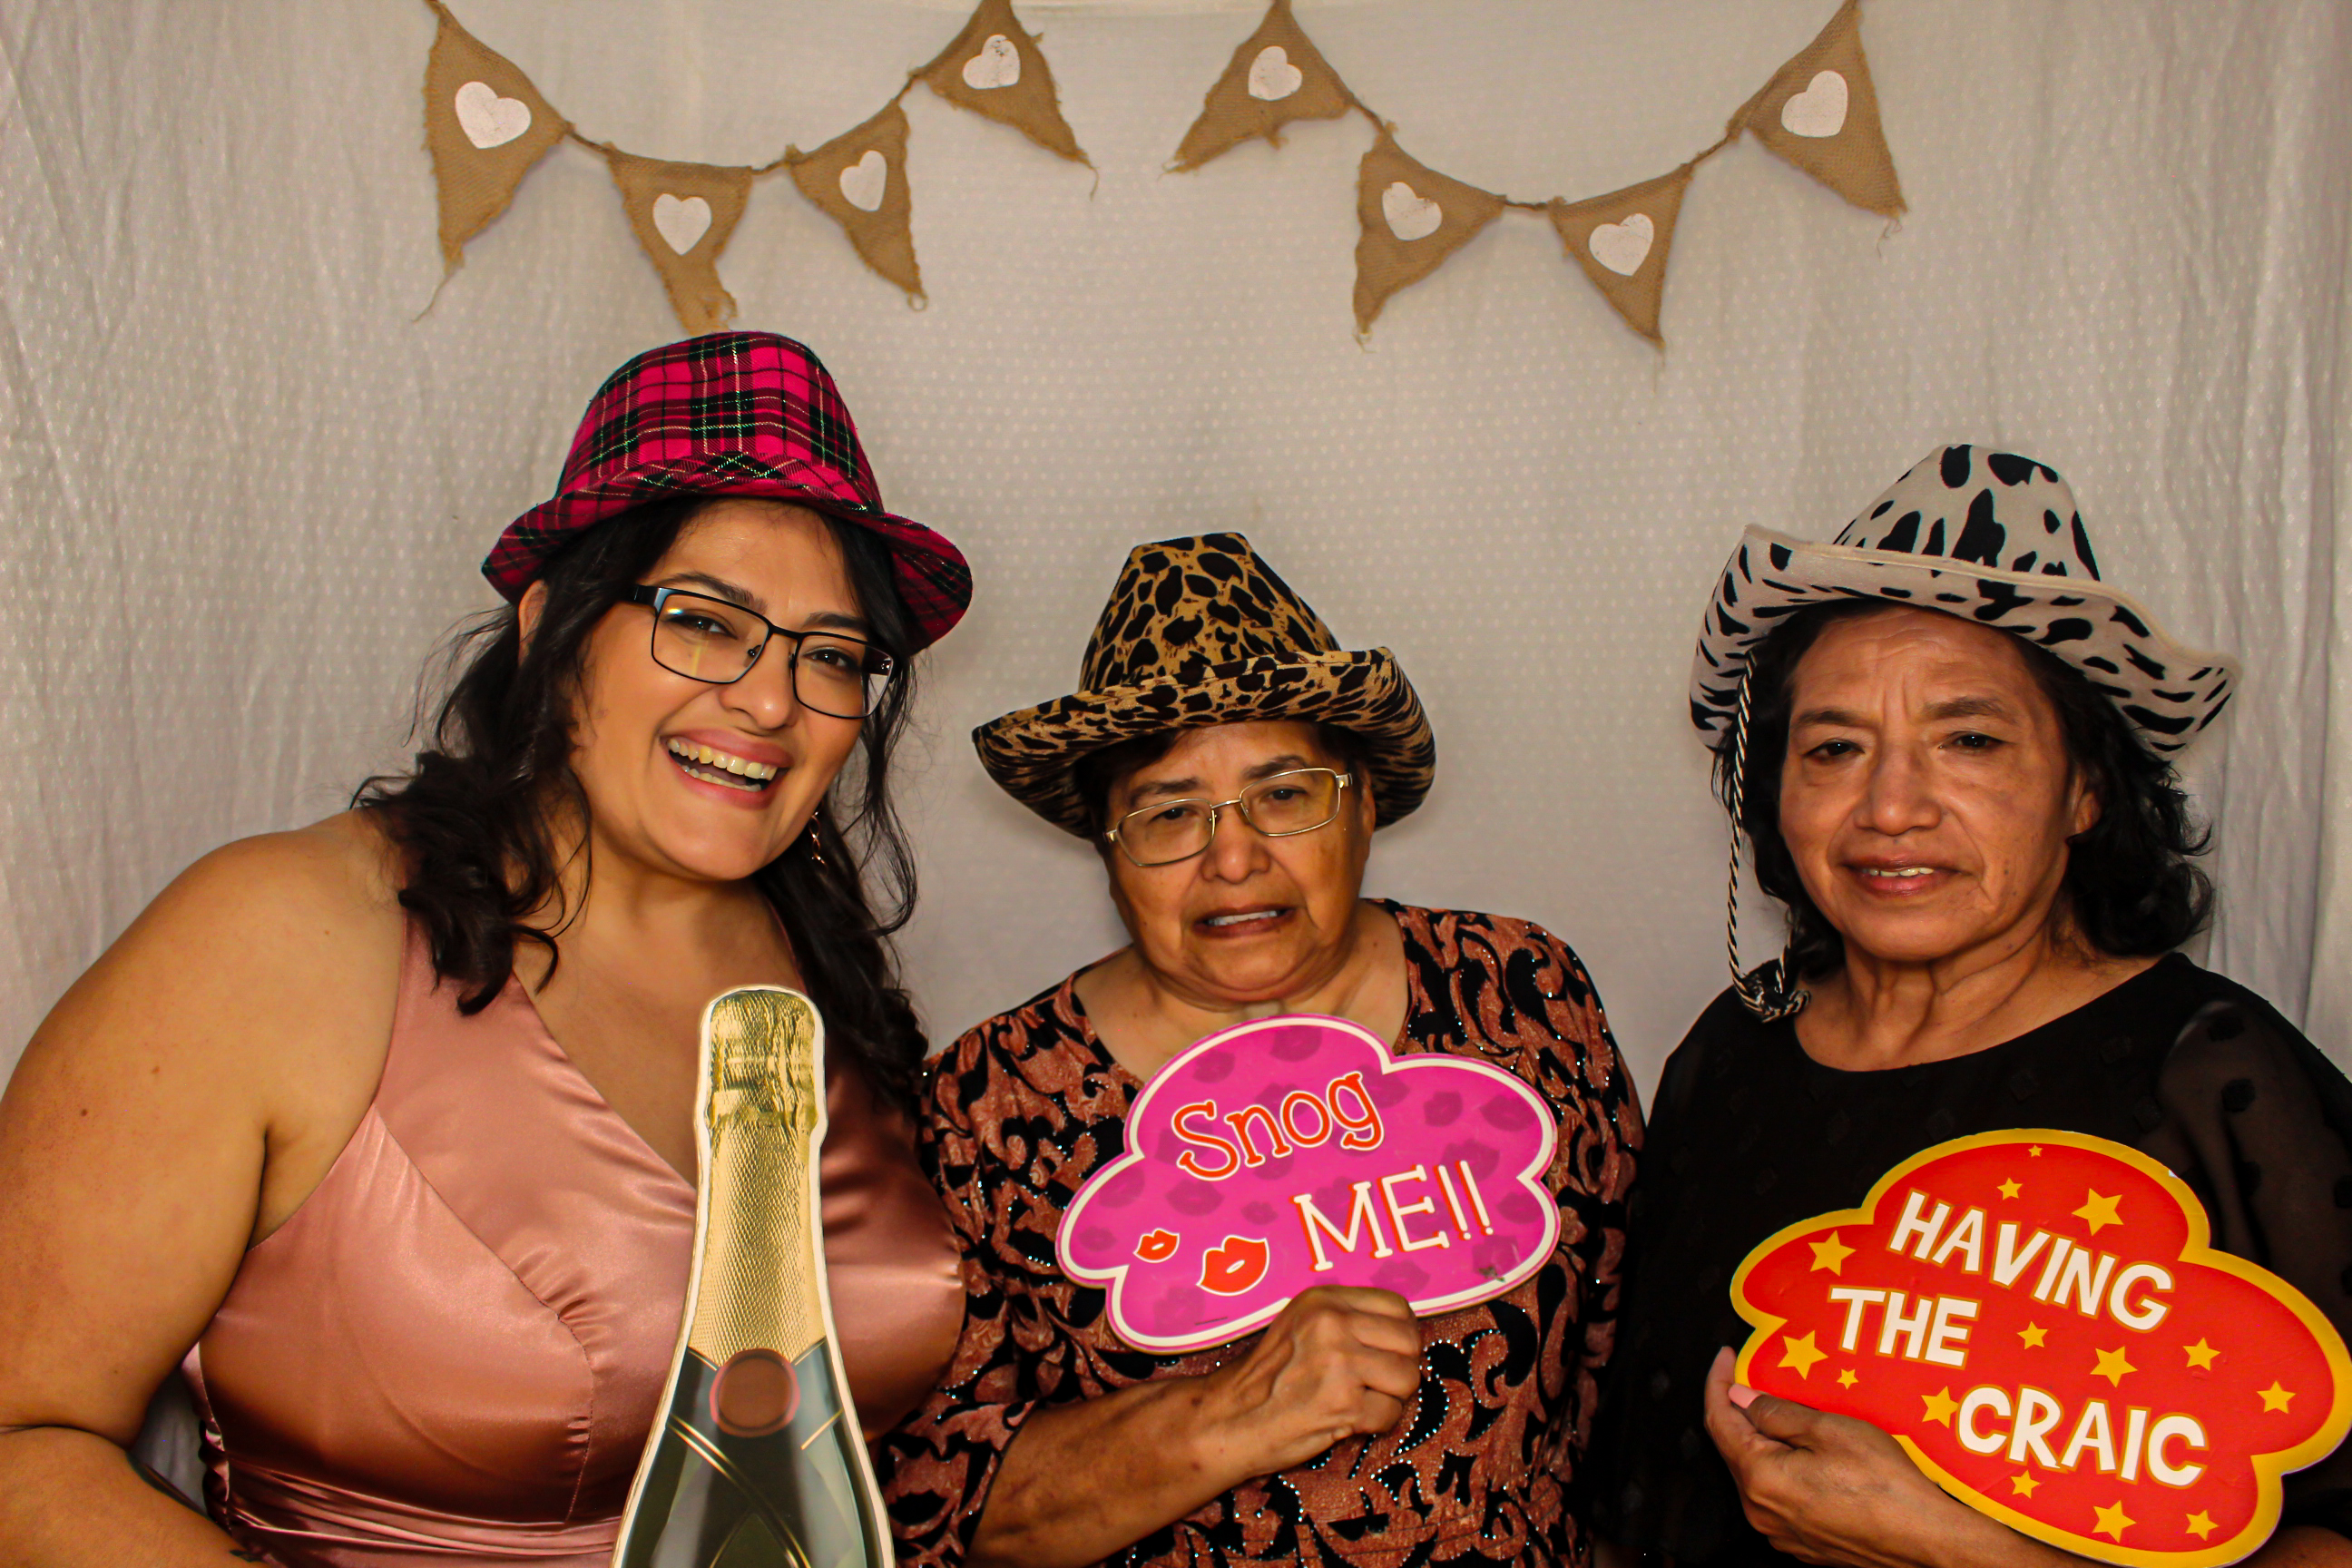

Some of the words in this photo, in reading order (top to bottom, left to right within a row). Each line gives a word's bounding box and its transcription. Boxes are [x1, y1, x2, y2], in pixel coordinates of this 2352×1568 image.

[1171, 1072, 1385, 1181] Snog
[1289, 1160, 1494, 1271] ME!!
[1887, 1189, 2174, 1331] HAVING
[1829, 1286, 1981, 1368] THE
[1956, 1384, 2208, 1487] CRAIC
